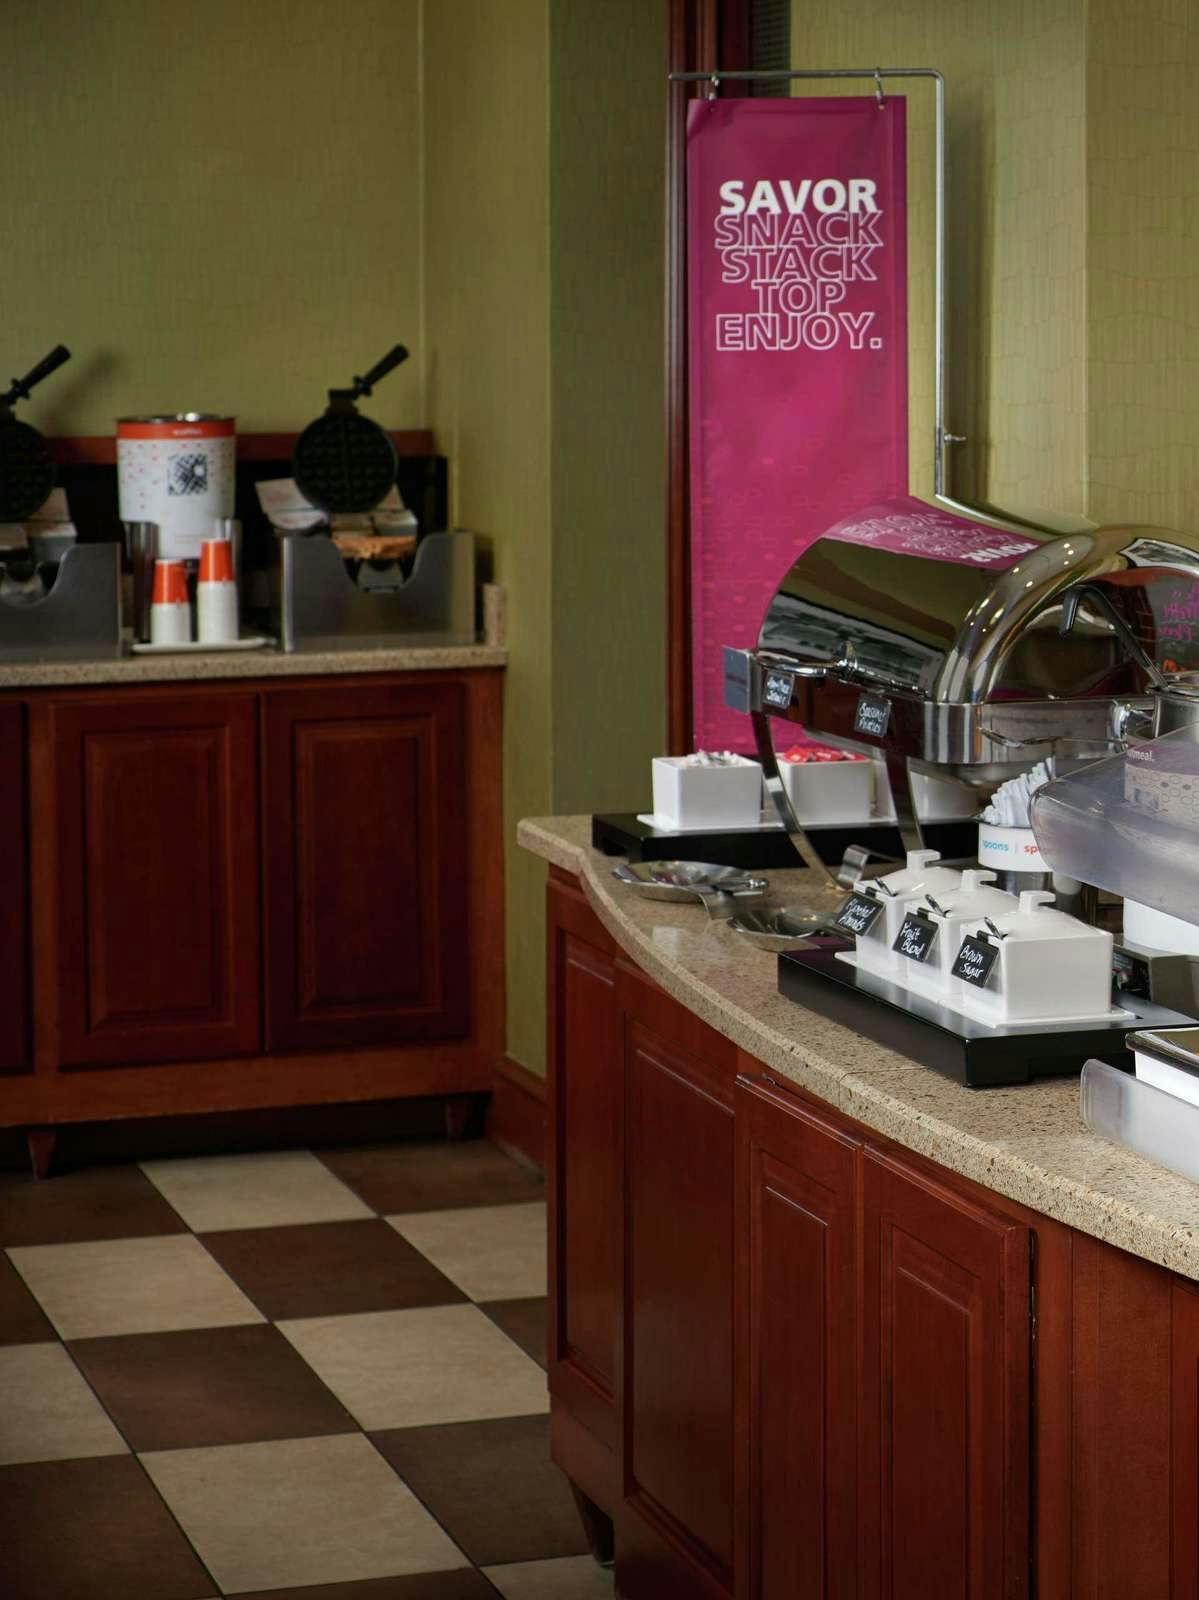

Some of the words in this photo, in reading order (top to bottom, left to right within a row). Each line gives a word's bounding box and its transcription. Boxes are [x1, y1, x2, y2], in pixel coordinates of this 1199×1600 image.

[719, 178, 877, 215] SAVOR
[714, 210, 884, 249] SNACK
[721, 244, 877, 284] STACK
[751, 278, 846, 317] TOP
[716, 312, 882, 351] ENJOY.
